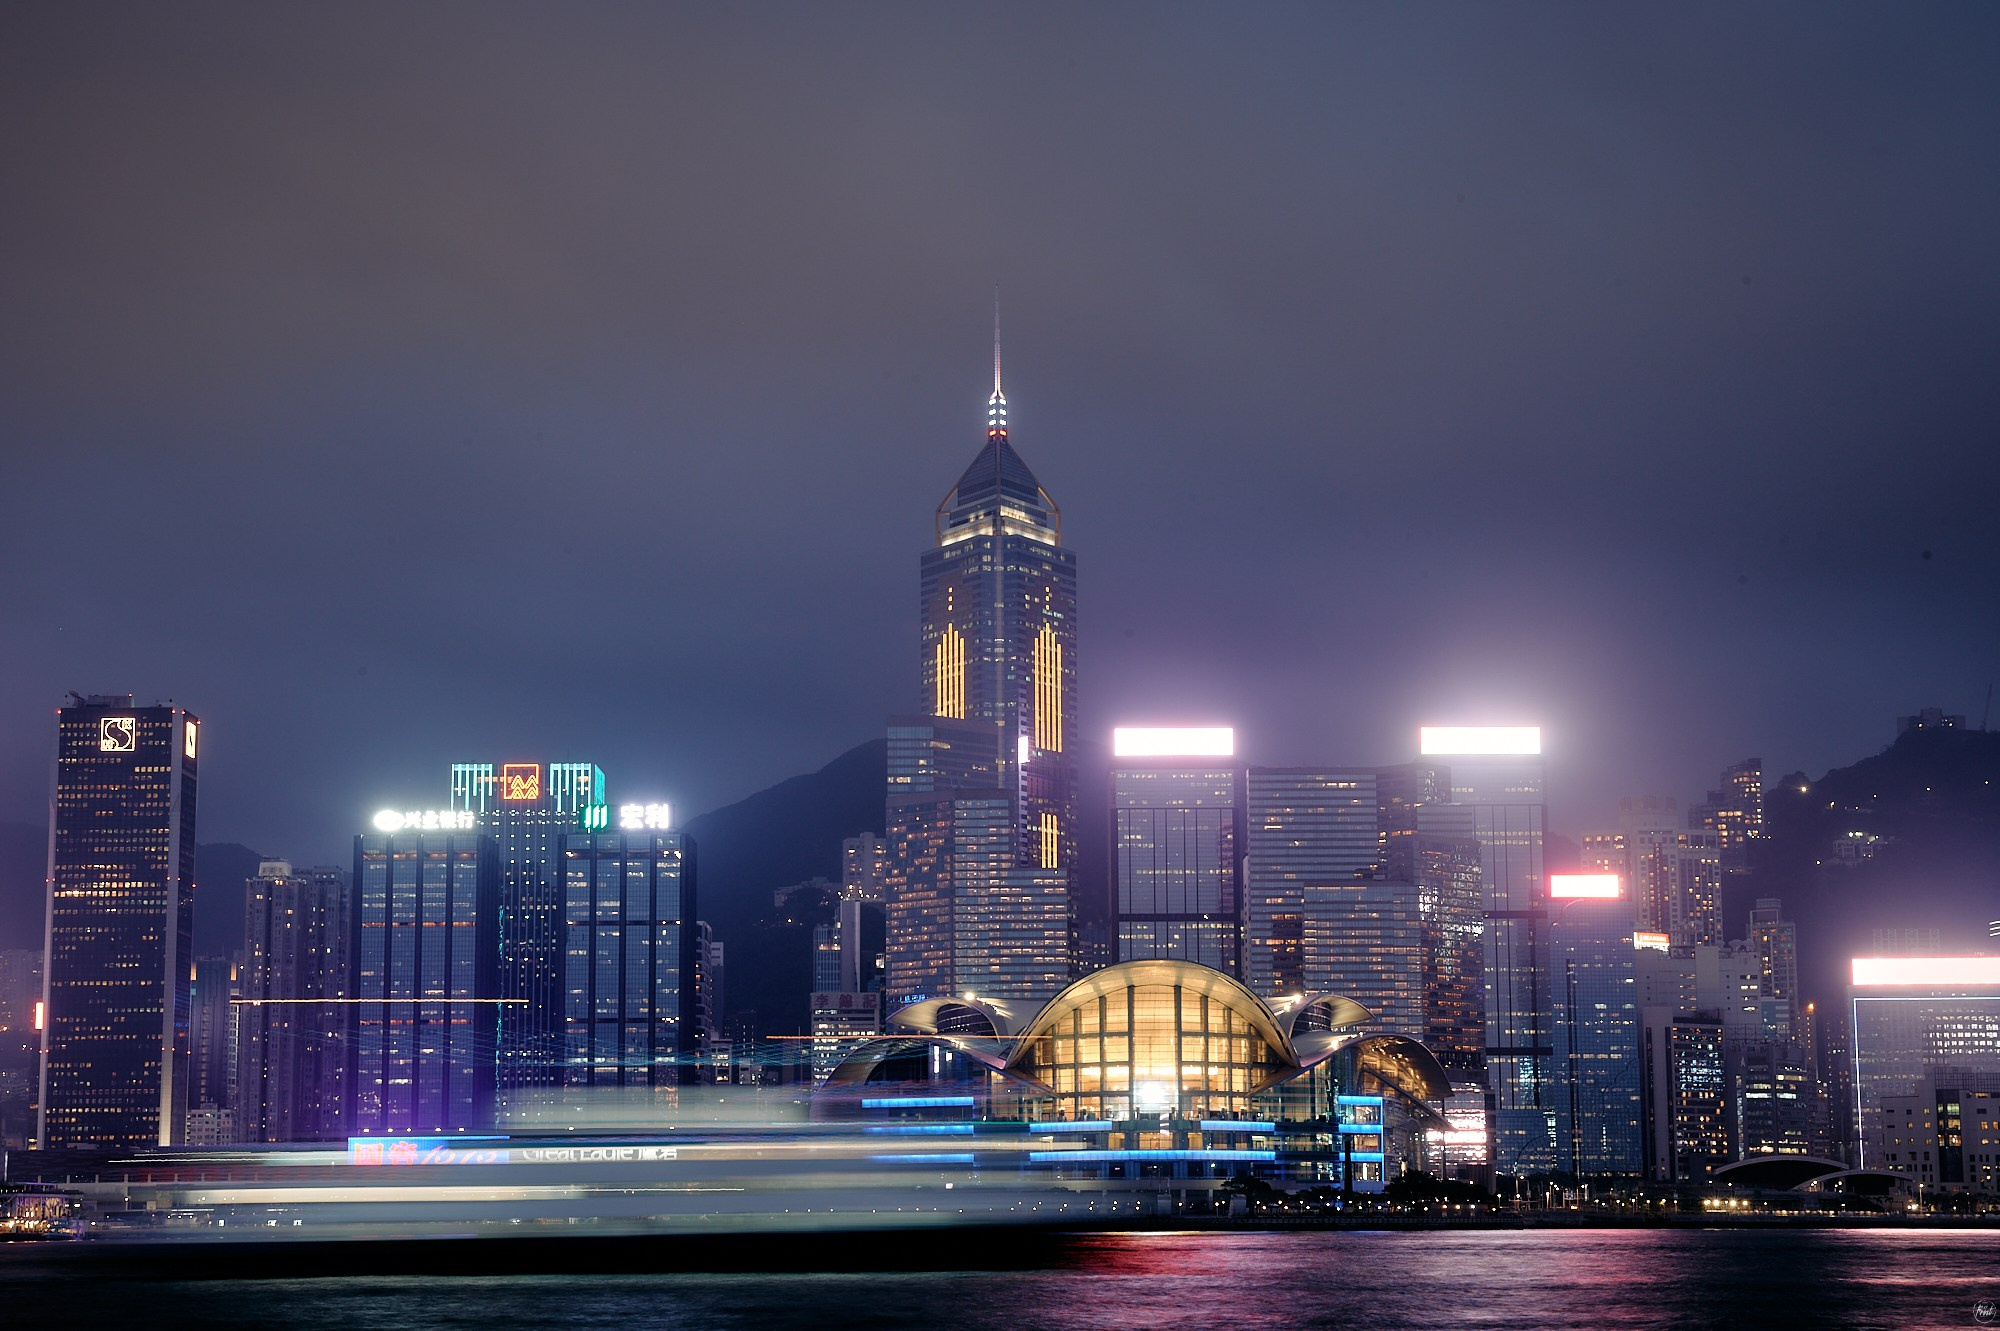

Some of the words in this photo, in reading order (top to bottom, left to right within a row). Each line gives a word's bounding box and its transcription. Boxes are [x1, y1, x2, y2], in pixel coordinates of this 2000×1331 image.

[404, 811, 474, 829] 兴业银行
[620, 804, 669, 828] 宏利
